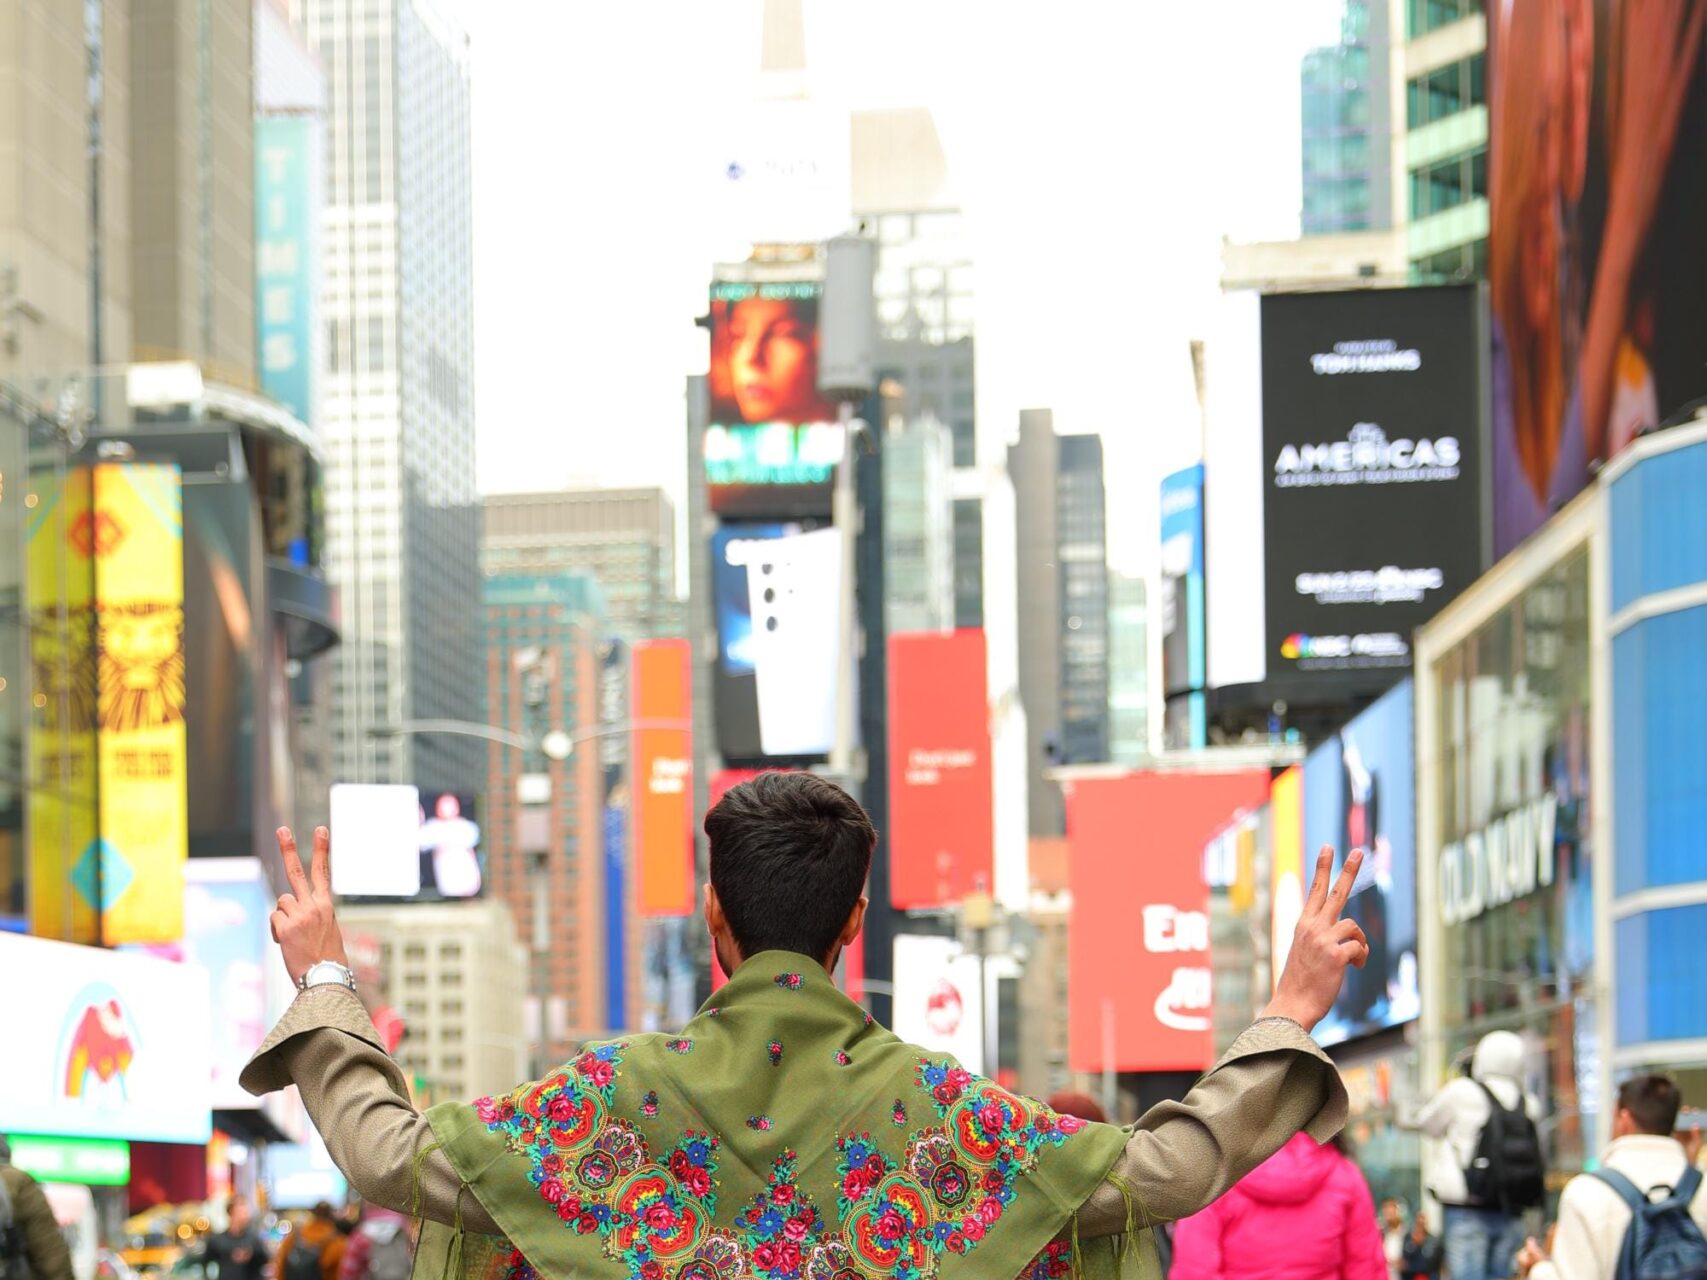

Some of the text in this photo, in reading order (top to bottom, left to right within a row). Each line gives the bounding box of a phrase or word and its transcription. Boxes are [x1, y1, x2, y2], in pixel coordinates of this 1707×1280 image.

[256, 146, 298, 374] TIMES
[1274, 436, 1461, 475] AMERICAS
[1439, 792, 1559, 926] OLD NAVY
